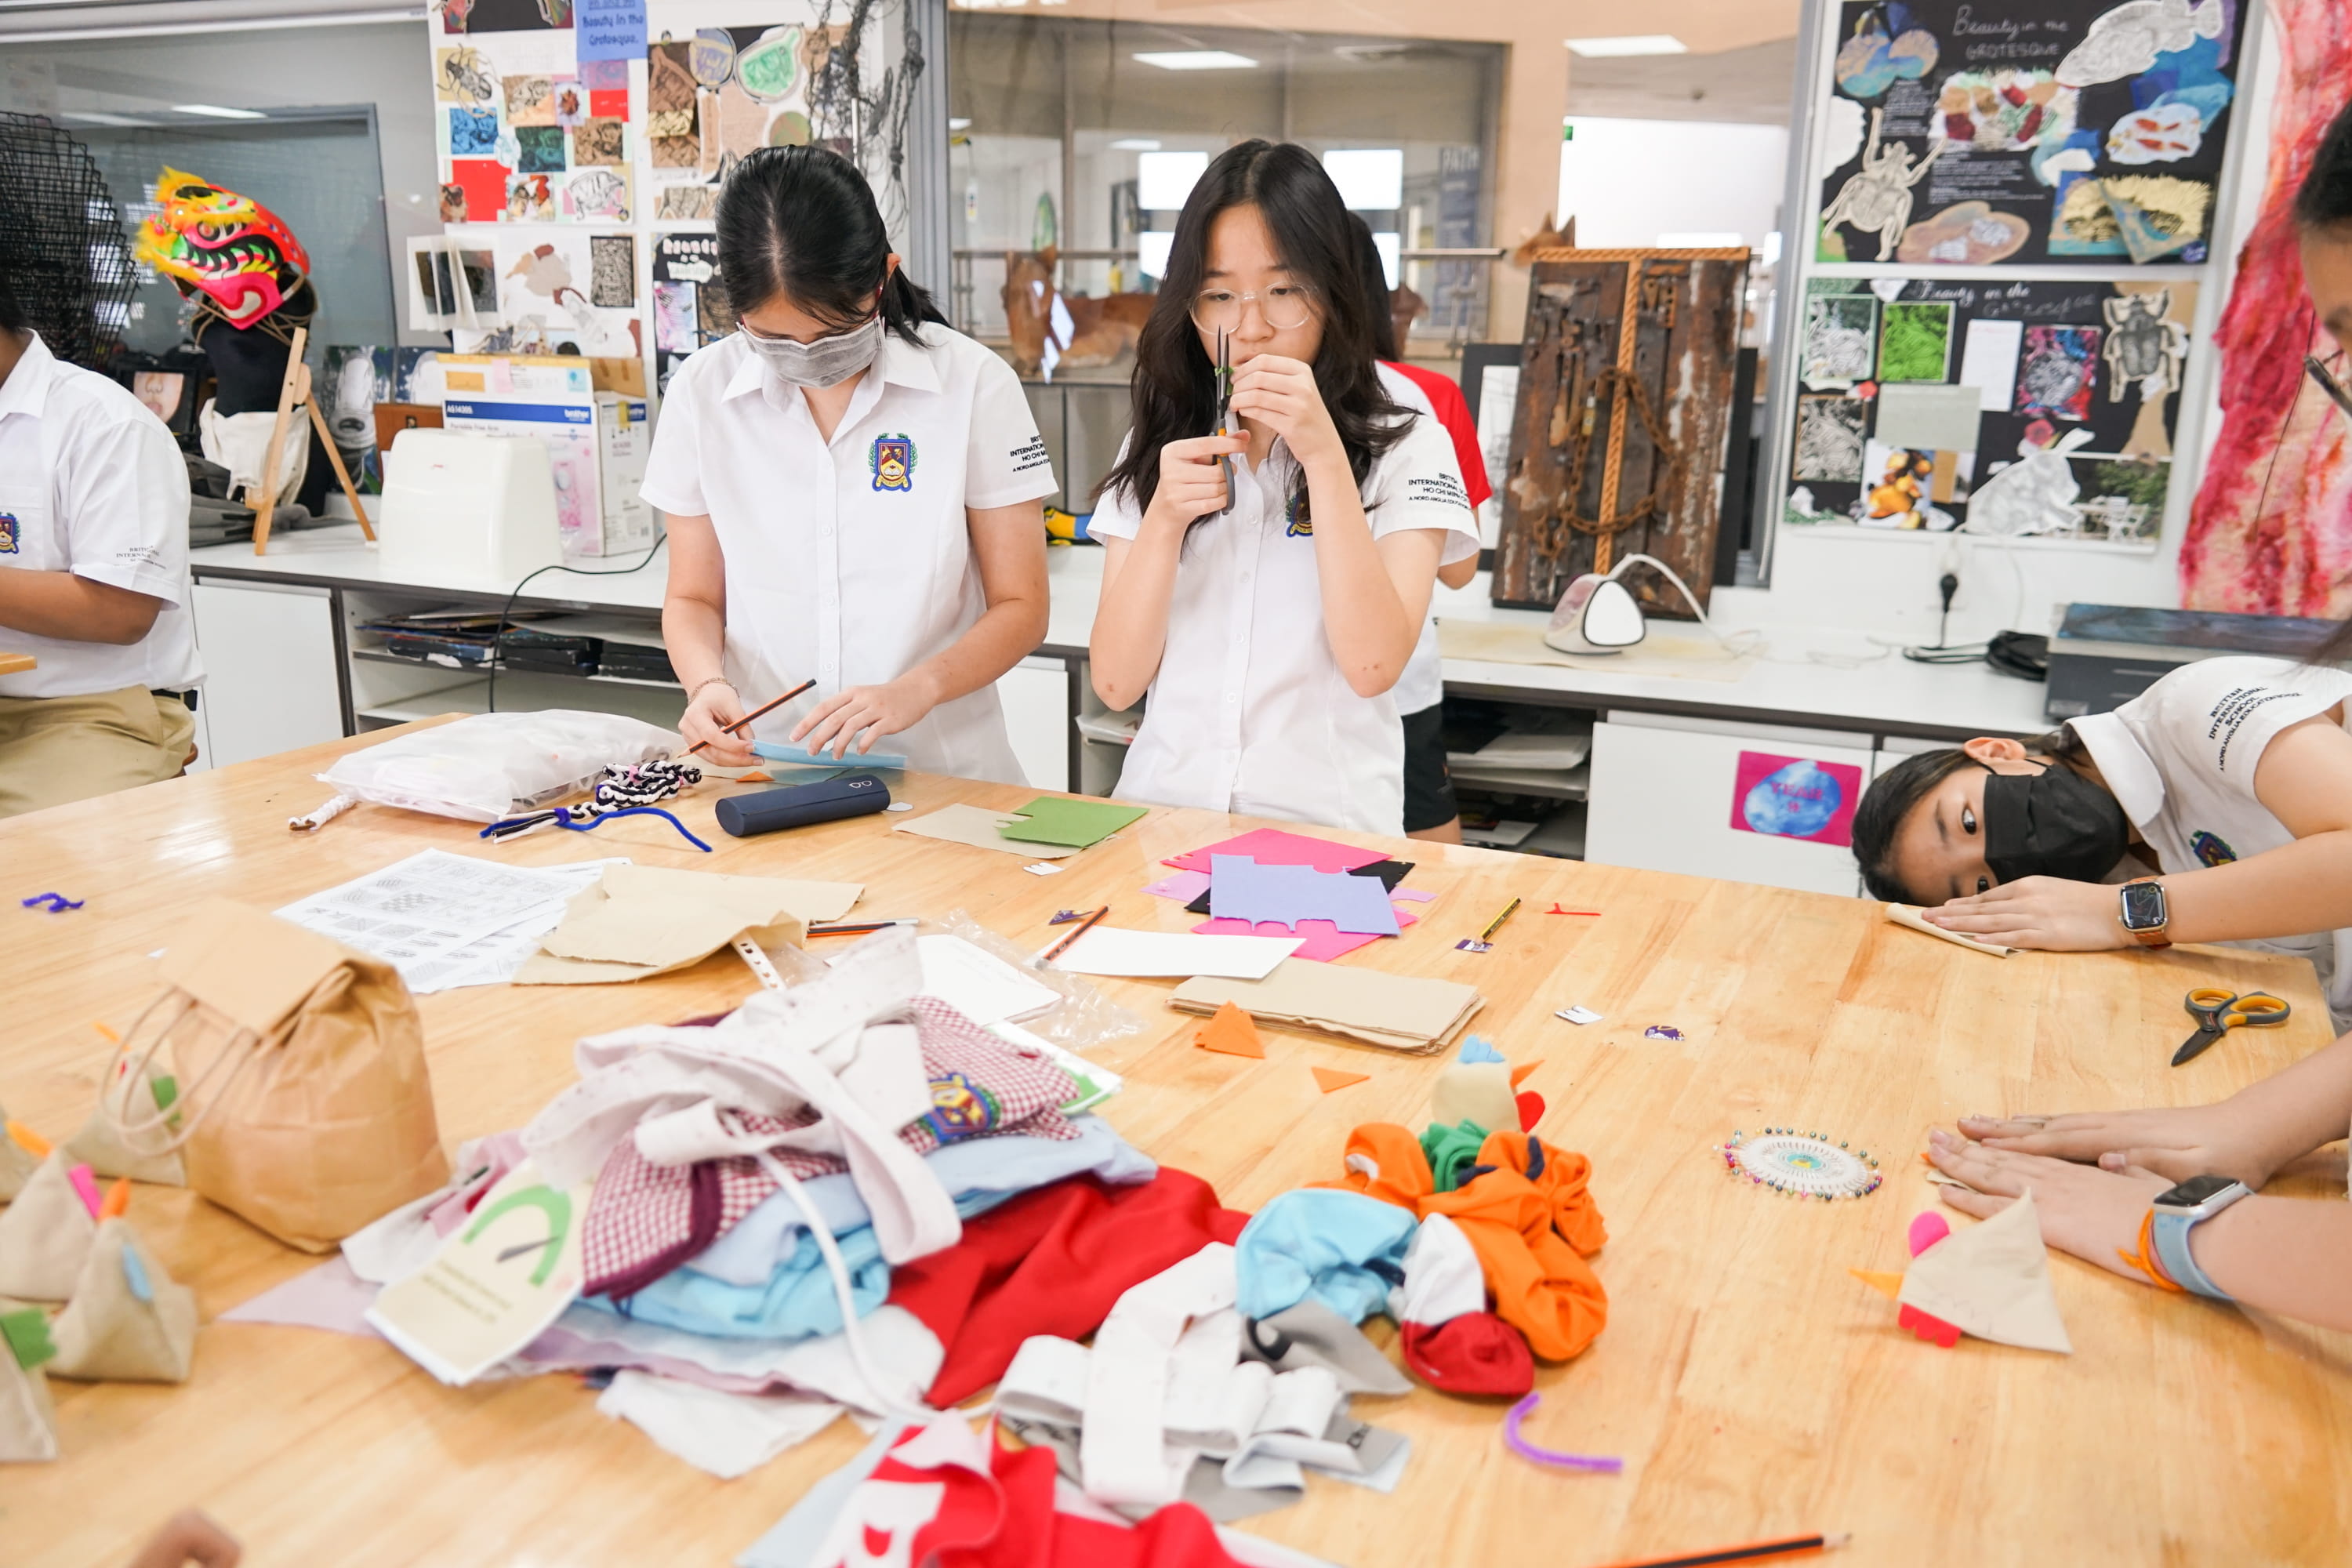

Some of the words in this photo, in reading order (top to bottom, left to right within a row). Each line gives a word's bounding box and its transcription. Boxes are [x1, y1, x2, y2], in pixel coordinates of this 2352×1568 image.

[1952, 4, 2020, 42] Beauty
[1965, 42, 2060, 60] GROTESQUE
[1030, 435, 1041, 444] BRIT
[1769, 782, 1823, 800] YEAR
